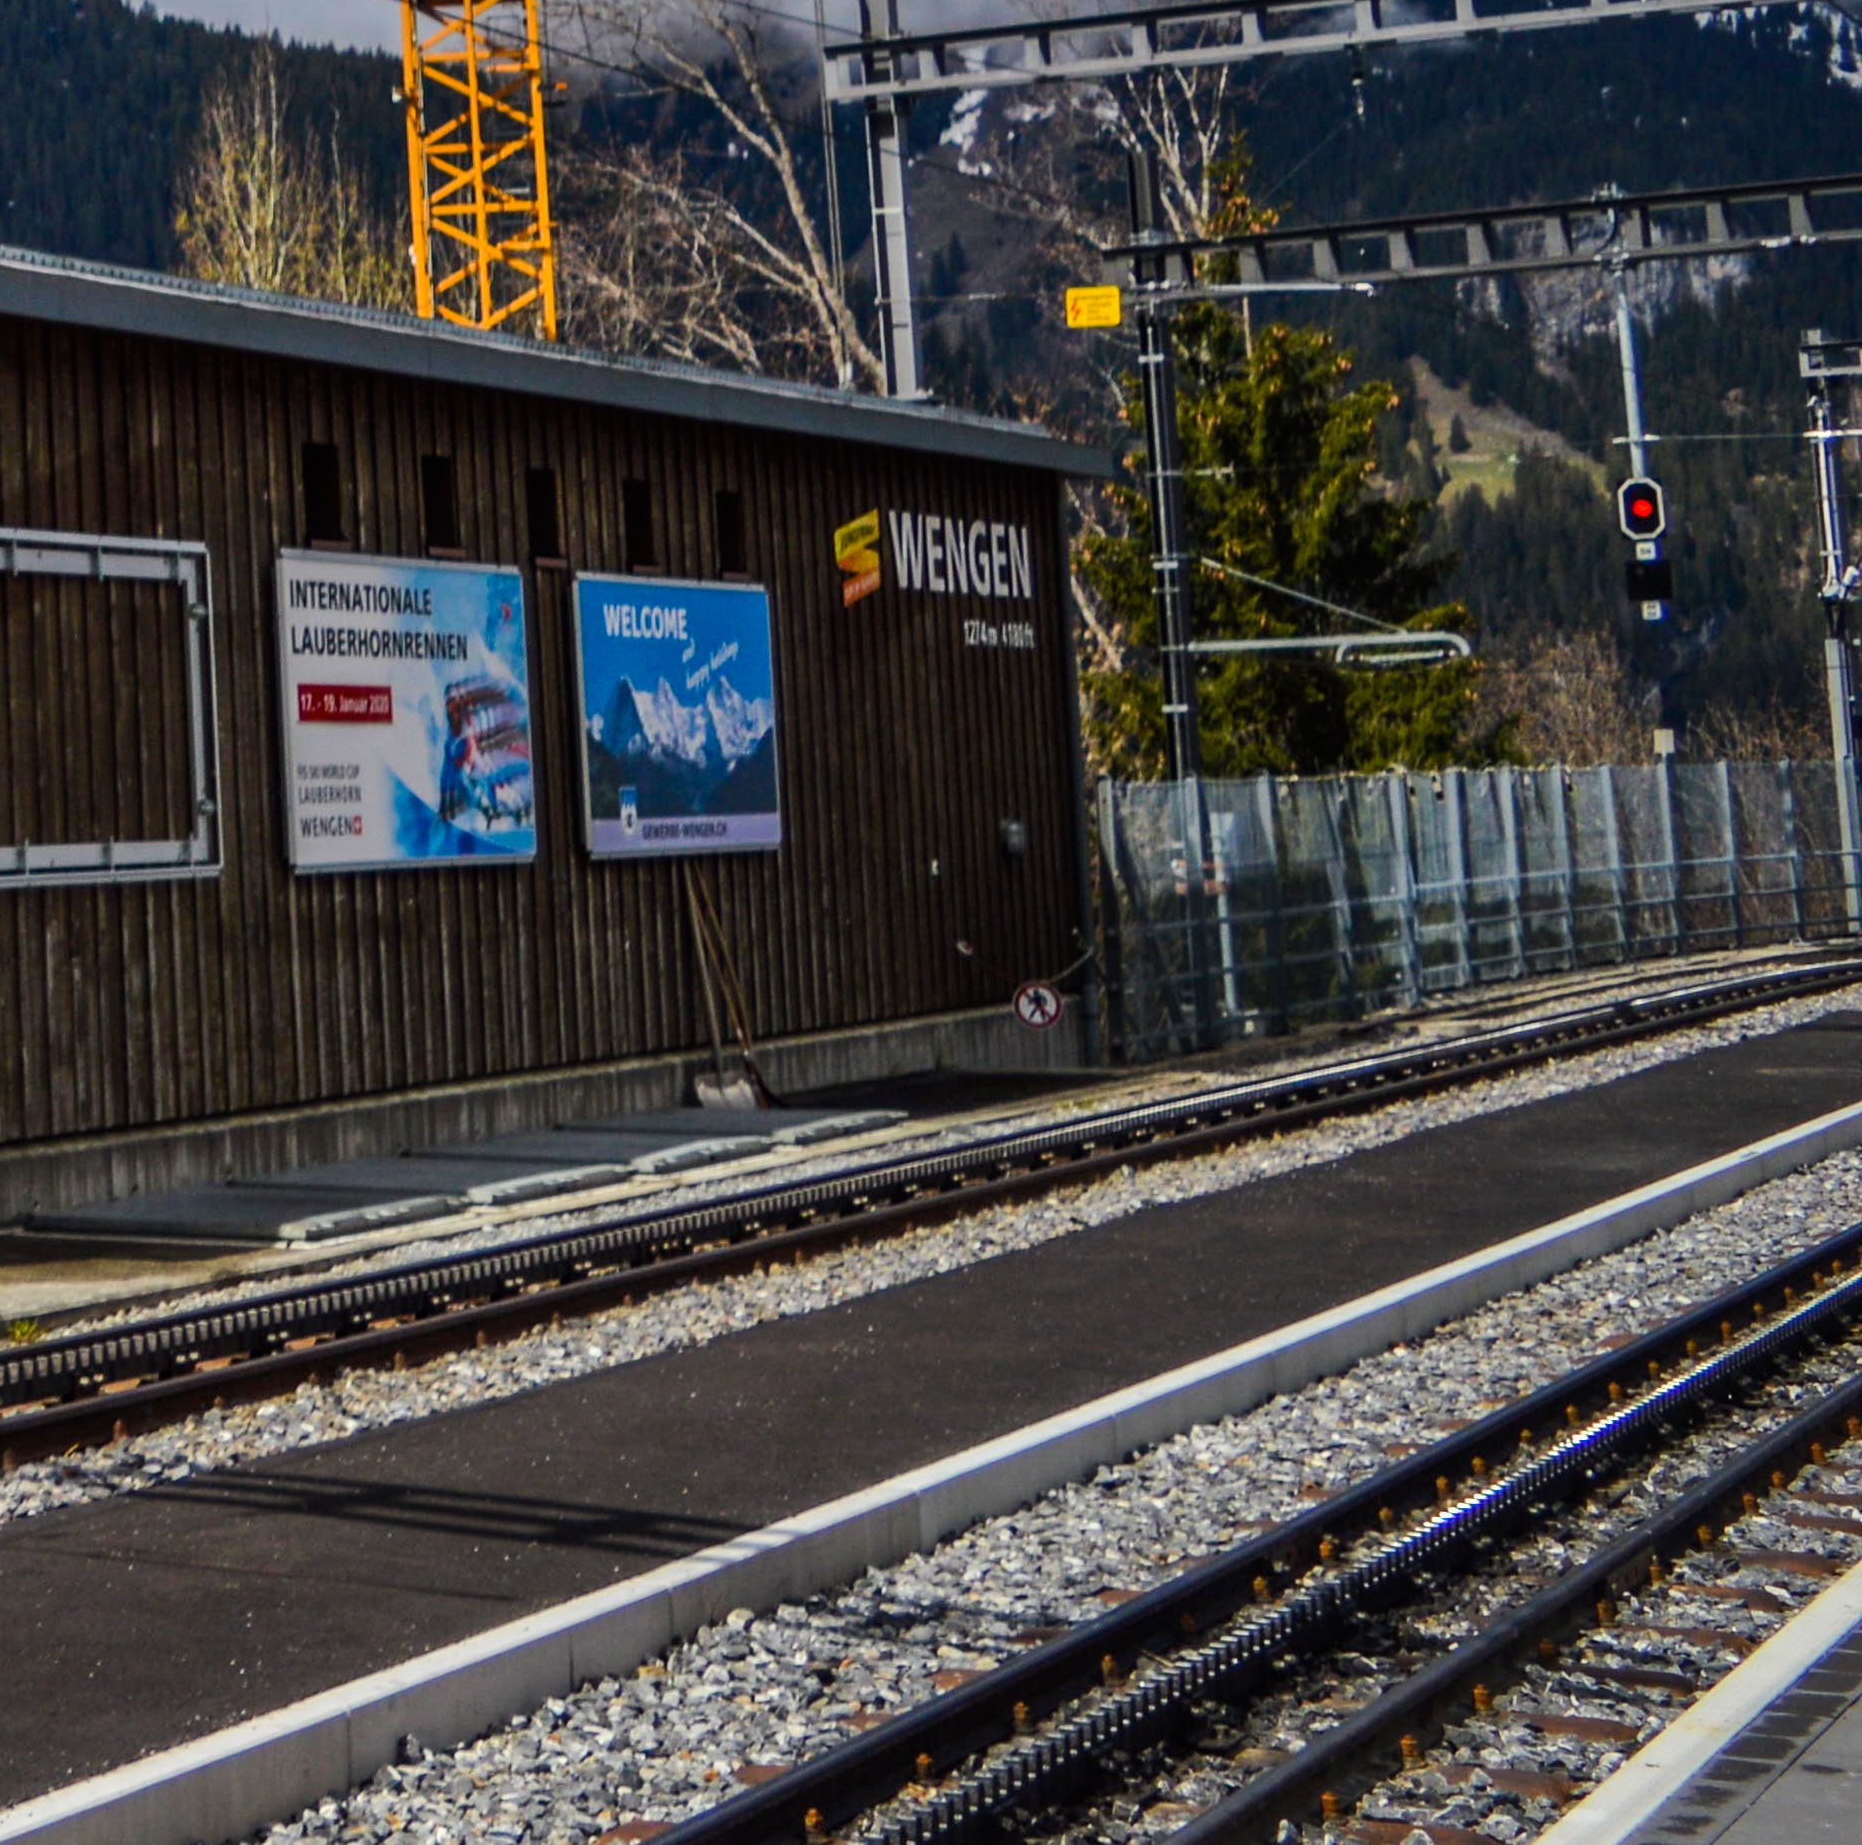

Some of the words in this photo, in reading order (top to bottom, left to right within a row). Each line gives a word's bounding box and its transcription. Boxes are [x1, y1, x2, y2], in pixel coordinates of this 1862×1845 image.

[889, 509, 1032, 598] WENGEN
[289, 579, 432, 616] INTERNATIONALE
[603, 603, 688, 640] WELCOME
[291, 626, 468, 661] LAUBERHORNRENNEN
[298, 785, 362, 804] LAUBERHORN
[300, 816, 353, 837] WENGEN
